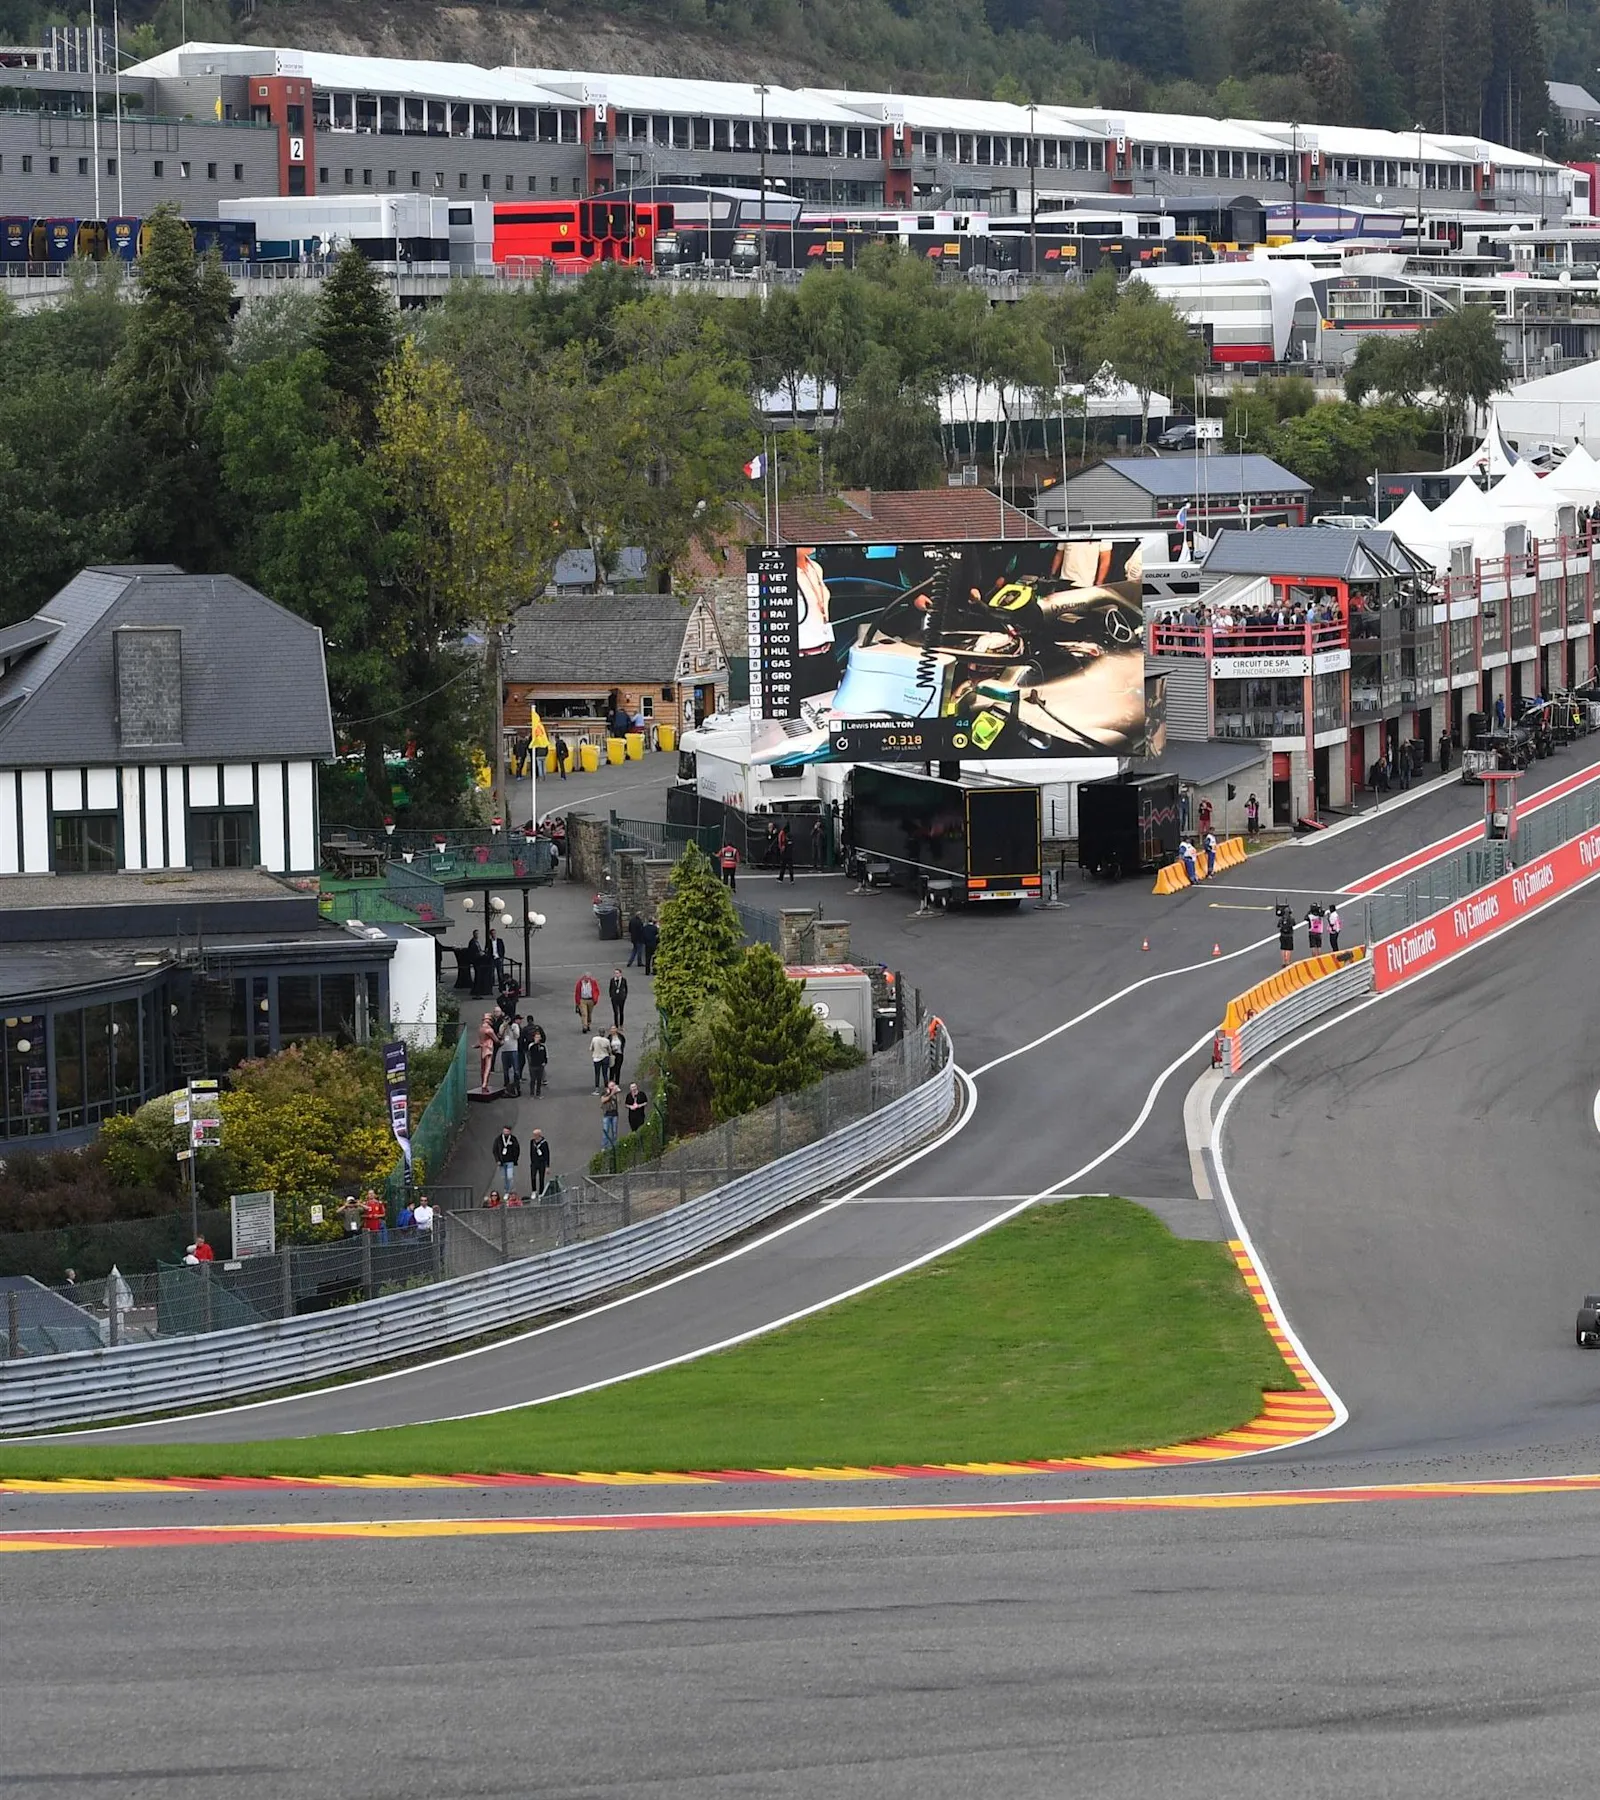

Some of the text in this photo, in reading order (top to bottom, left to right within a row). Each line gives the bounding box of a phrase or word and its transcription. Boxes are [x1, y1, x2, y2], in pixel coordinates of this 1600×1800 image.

[598, 104, 605, 121] 3
[895, 124, 901, 138] 4
[294, 140, 301, 158] 2
[1118, 138, 1125, 152] 5
[1312, 149, 1318, 163] 6
[1483, 161, 1490, 174] 7
[8, 226, 22, 235] FIA
[54, 226, 68, 236] FIA
[116, 225, 130, 236] FIA
[758, 562, 785, 570] 22:47
[769, 574, 788, 582] VET
[769, 586, 788, 594] VER
[769, 598, 793, 606] HAM
[770, 623, 790, 631] BOT
[770, 635, 790, 643] OCO
[771, 660, 791, 668] GAS
[1233, 659, 1290, 668] CIRCUIT DE SPA
[771, 672, 792, 680] GRO
[1233, 667, 1291, 676] FRANCORCHAMPS
[772, 697, 790, 705] LEC
[772, 709, 788, 717] ERI
[869, 721, 914, 729] HAMILTON
[956, 719, 969, 727] 44
[881, 735, 922, 746] +0.318
[1579, 840, 1592, 867] Fly
[1512, 864, 1553, 906] Fly Emirates
[1454, 894, 1499, 938] Fly Emirates
[1387, 928, 1436, 973] Fly Emirates
[311, 1206, 322, 1215] 53
